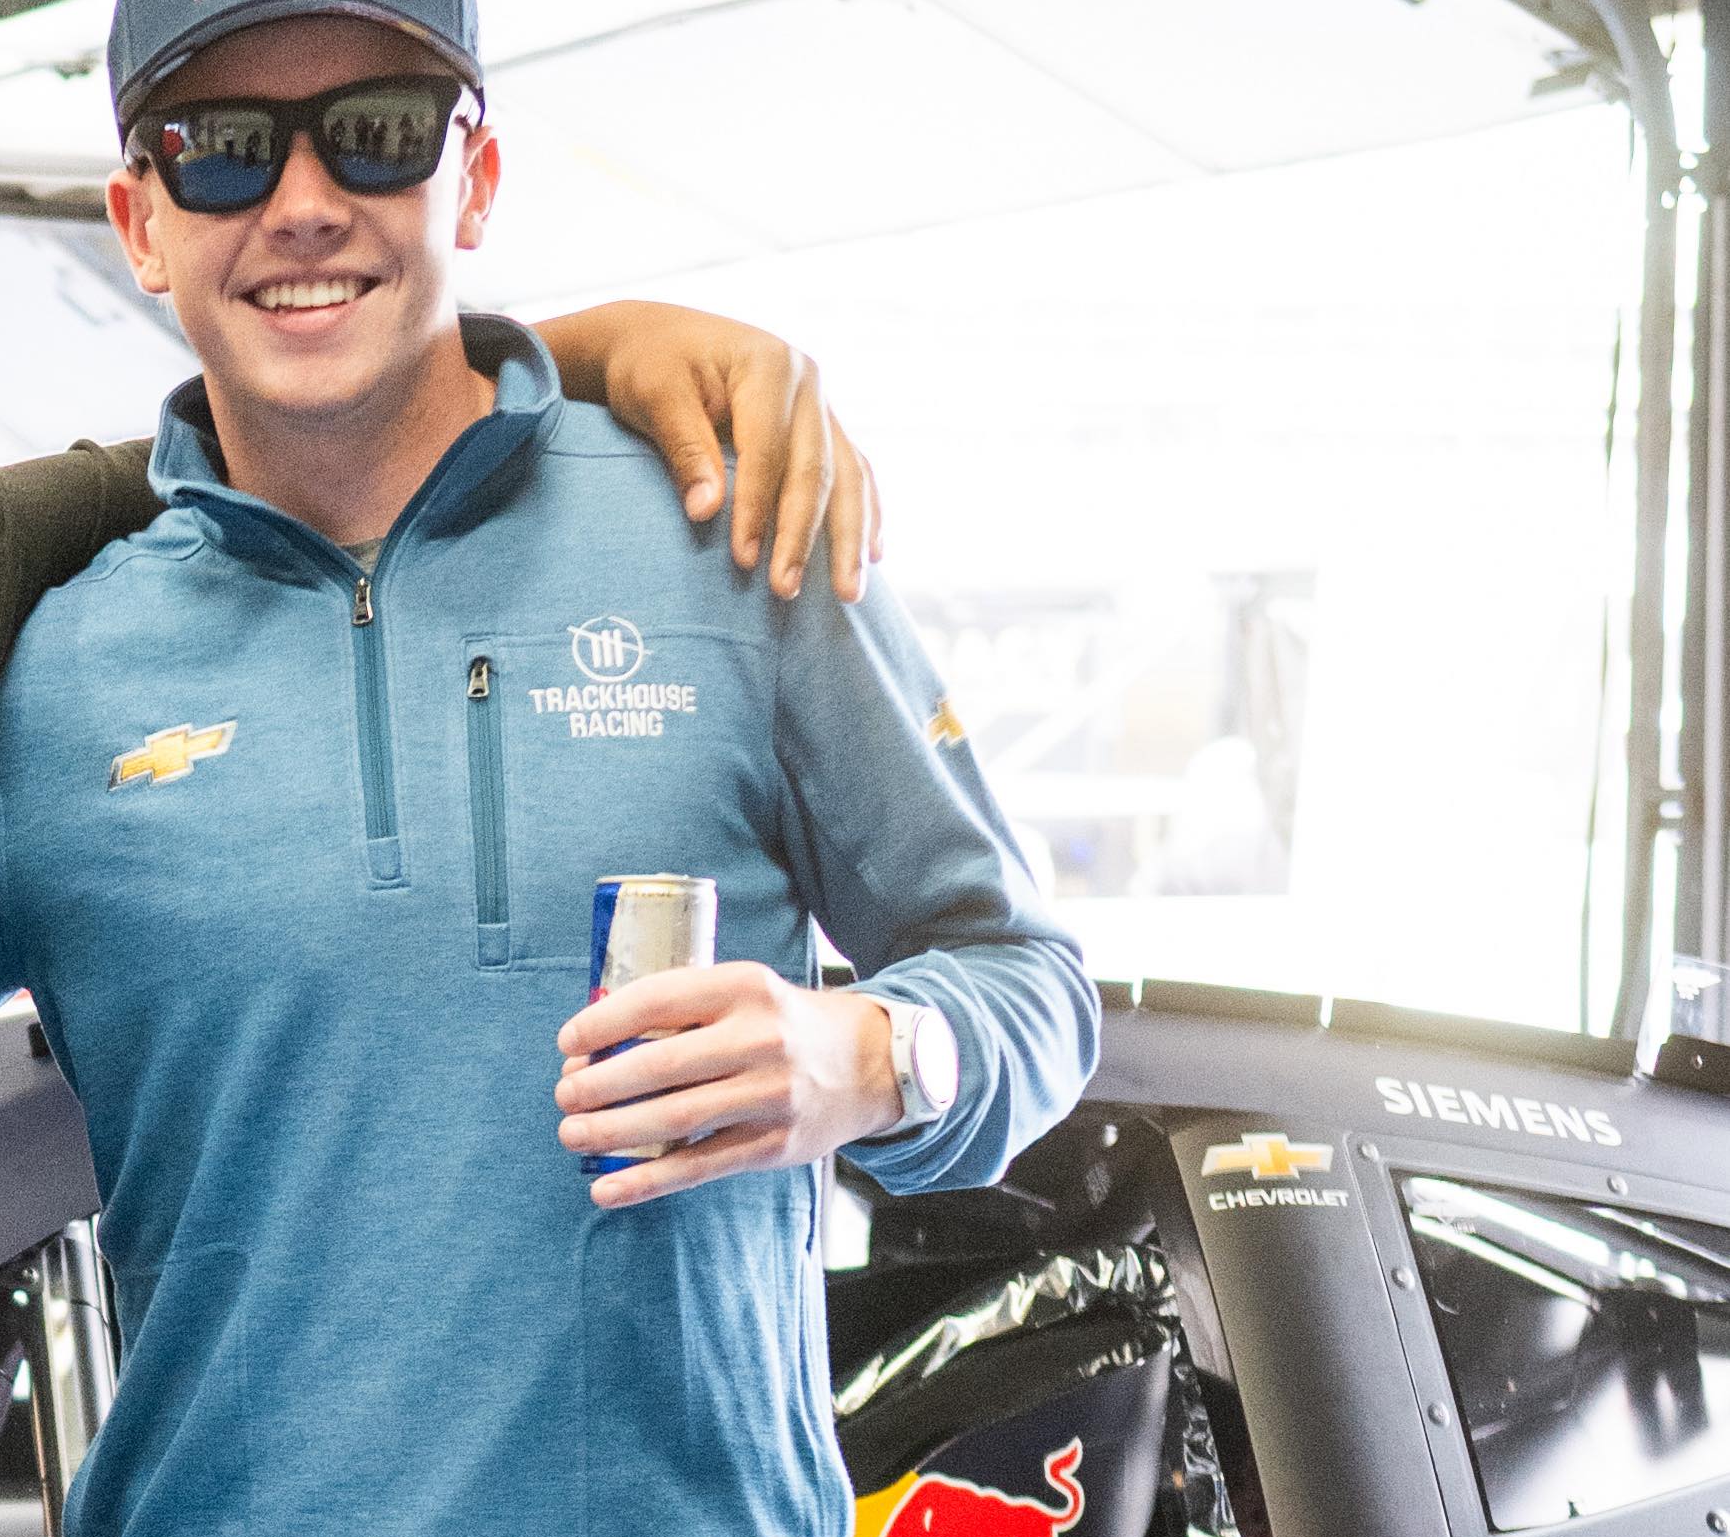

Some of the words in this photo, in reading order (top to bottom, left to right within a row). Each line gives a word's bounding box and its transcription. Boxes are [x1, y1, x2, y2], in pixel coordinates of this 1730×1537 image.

[528, 683, 698, 713] TRACKHOUSE
[569, 710, 664, 738] RACING
[1375, 1076, 1623, 1147] SIEMENS
[1208, 1188, 1350, 1212] CHEVROLET
